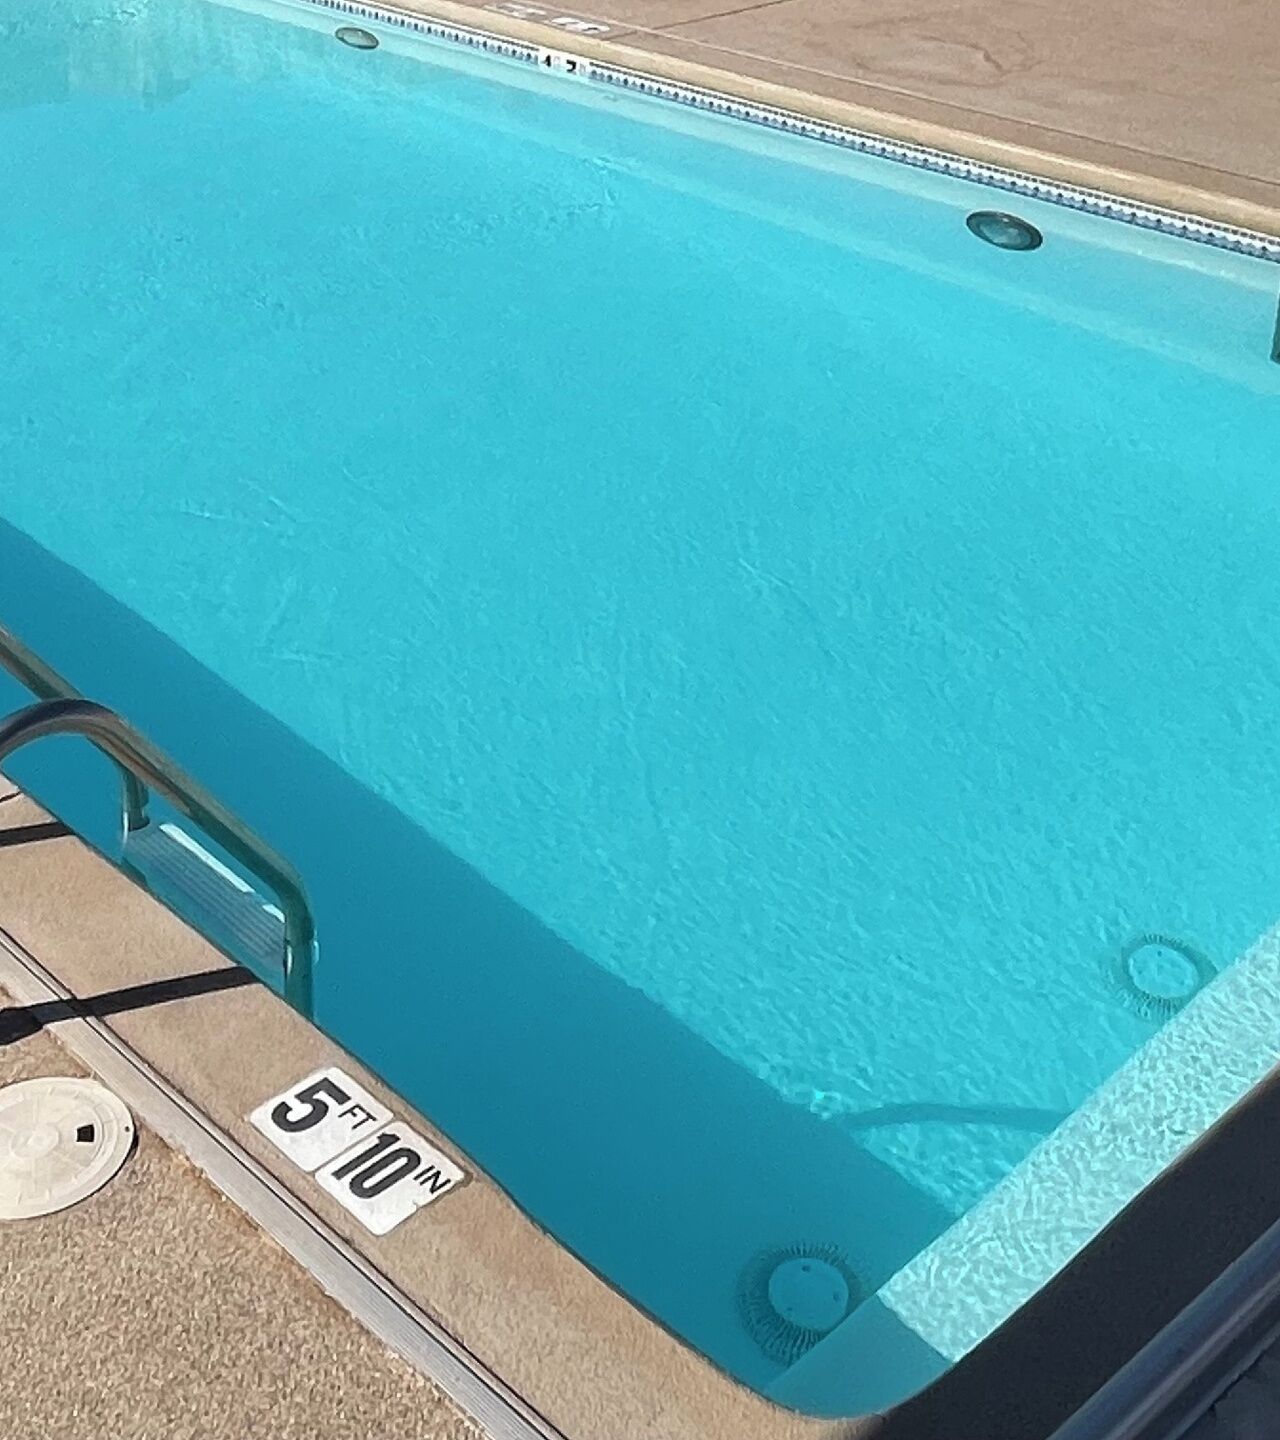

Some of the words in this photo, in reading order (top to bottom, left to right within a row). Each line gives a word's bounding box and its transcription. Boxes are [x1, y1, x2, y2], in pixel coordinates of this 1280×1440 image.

[271, 1077, 352, 1133] 5
[338, 1103, 377, 1130] FT
[331, 1132, 422, 1199] 10
[412, 1165, 451, 1194] IN
